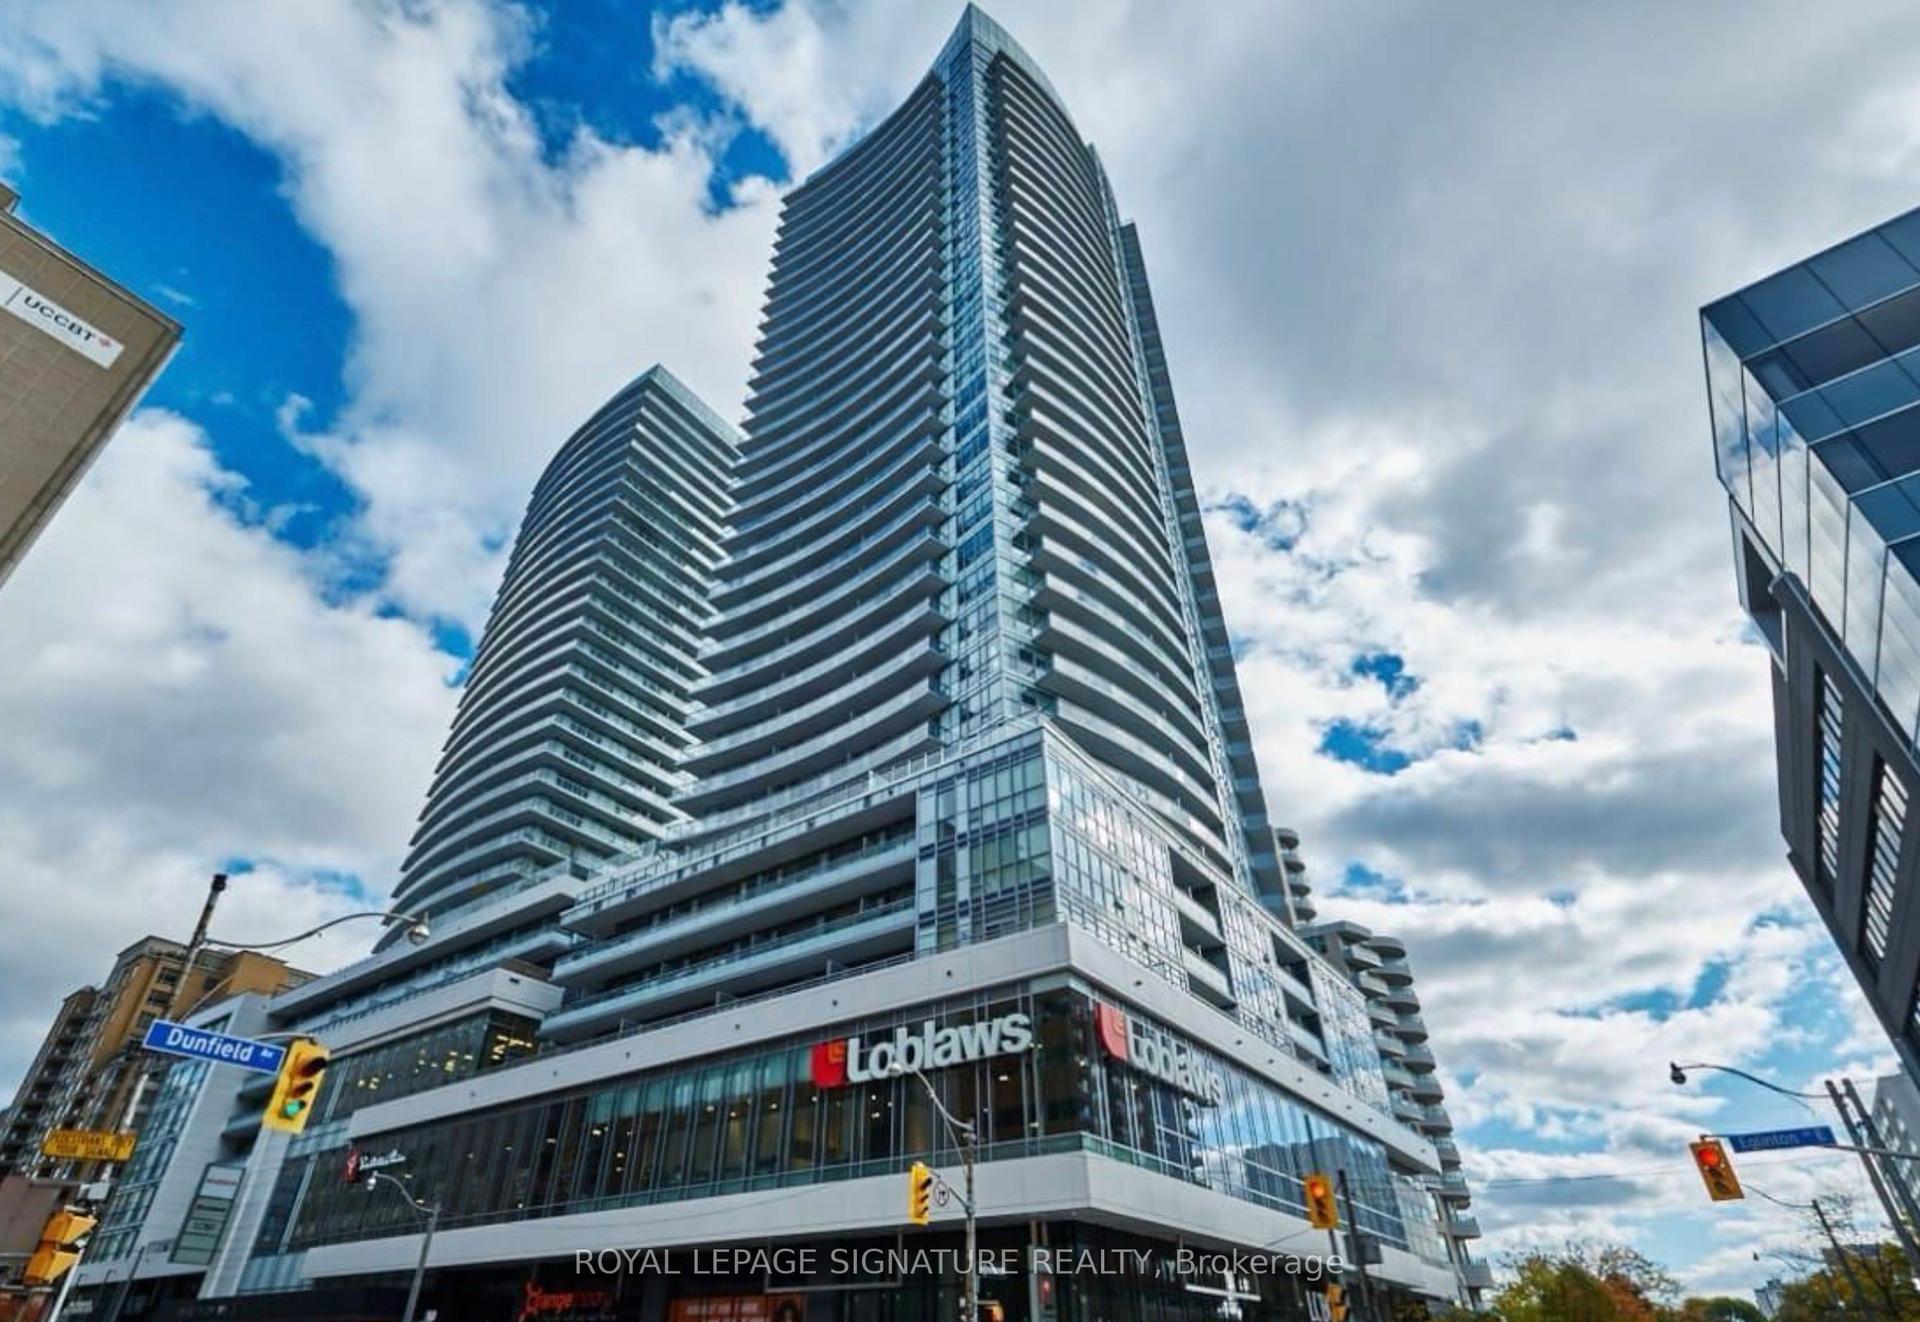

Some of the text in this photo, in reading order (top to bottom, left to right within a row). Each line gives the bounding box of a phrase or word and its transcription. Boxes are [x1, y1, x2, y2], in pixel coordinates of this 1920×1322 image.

[24, 295, 95, 342] UCCBT
[166, 1027, 255, 1062] Dunfield
[847, 1012, 1033, 1083] Loblaws
[1126, 1014, 1223, 1104] Loblaws
[1738, 1133, 1800, 1150] Eglinton
